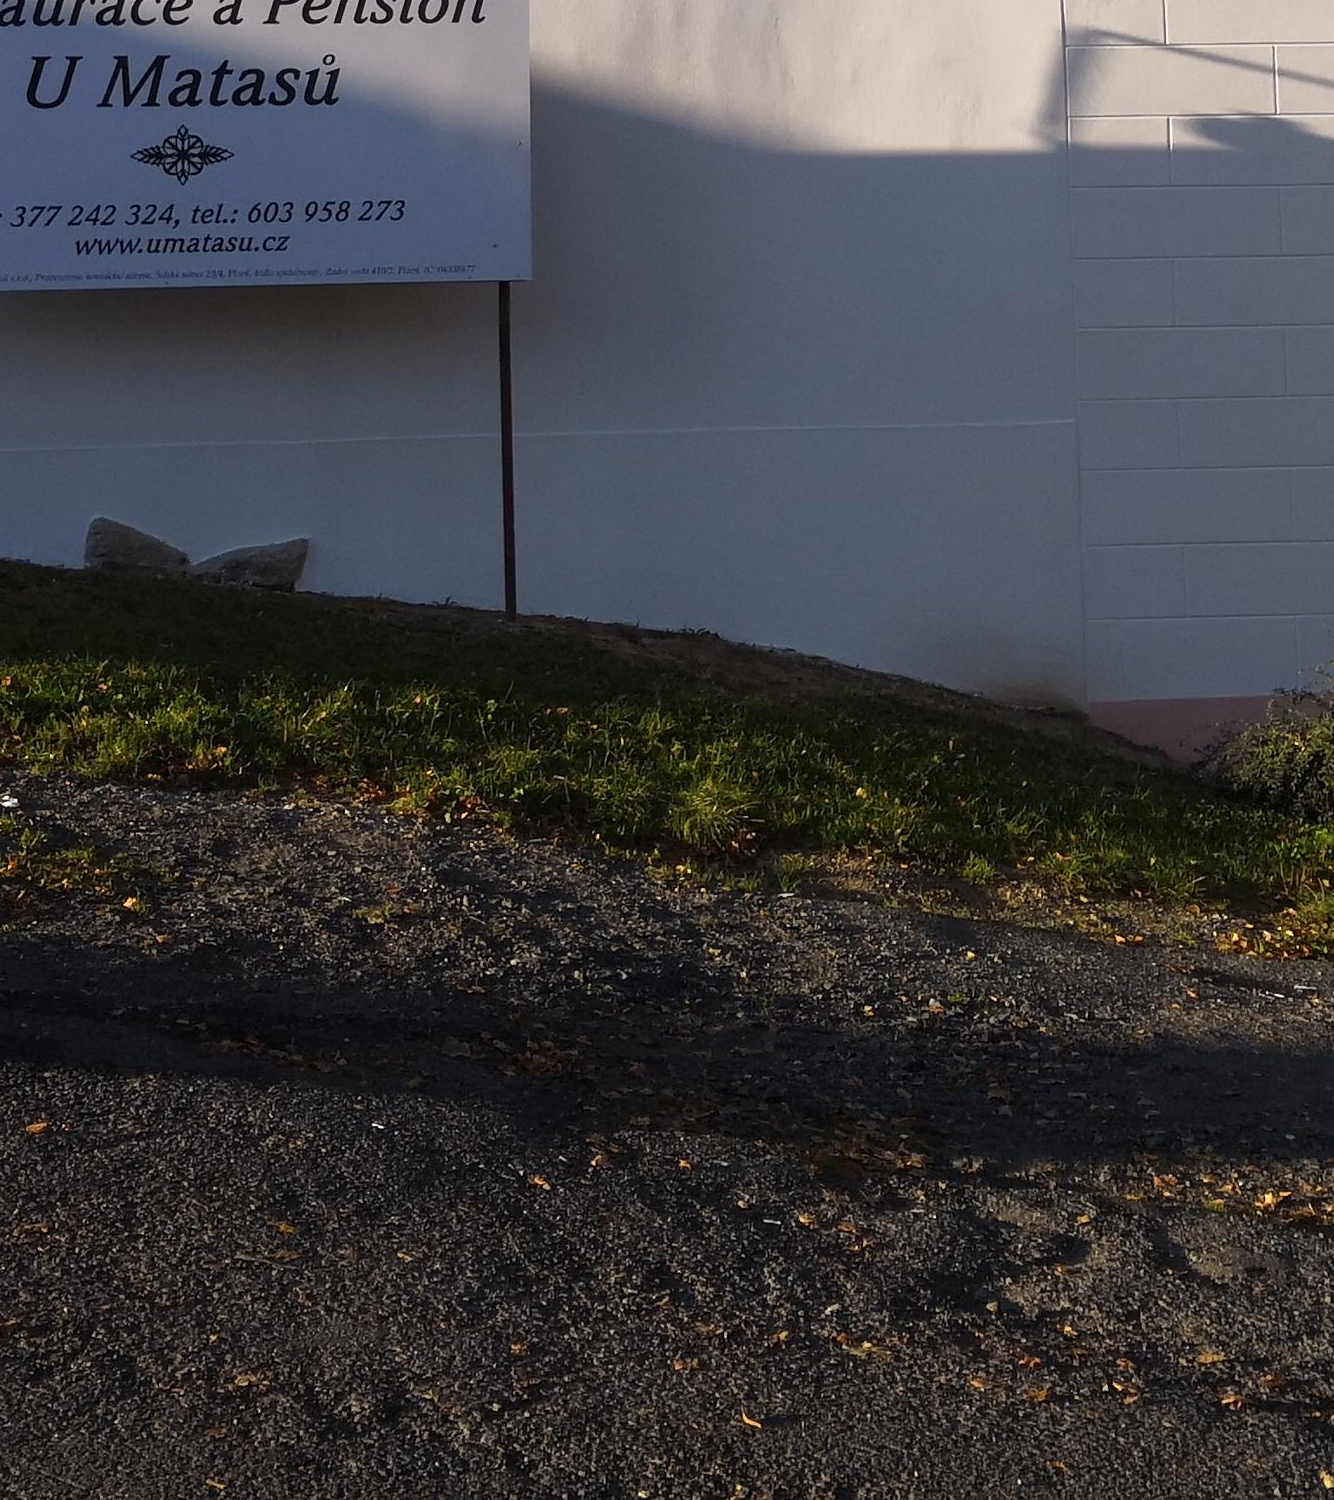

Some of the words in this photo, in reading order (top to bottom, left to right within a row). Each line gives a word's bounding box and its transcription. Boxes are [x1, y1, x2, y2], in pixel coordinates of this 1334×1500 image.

[26, 56, 83, 109] U
[96, 54, 341, 108] Matasů
[9, 205, 63, 228] 377
[67, 204, 117, 227] 242
[124, 203, 180, 230] 324,
[191, 203, 239, 225] tel.:
[247, 201, 294, 223] 603
[304, 201, 351, 223] 958
[357, 200, 406, 222] 273
[74, 233, 291, 257] www.umatasu.cz
